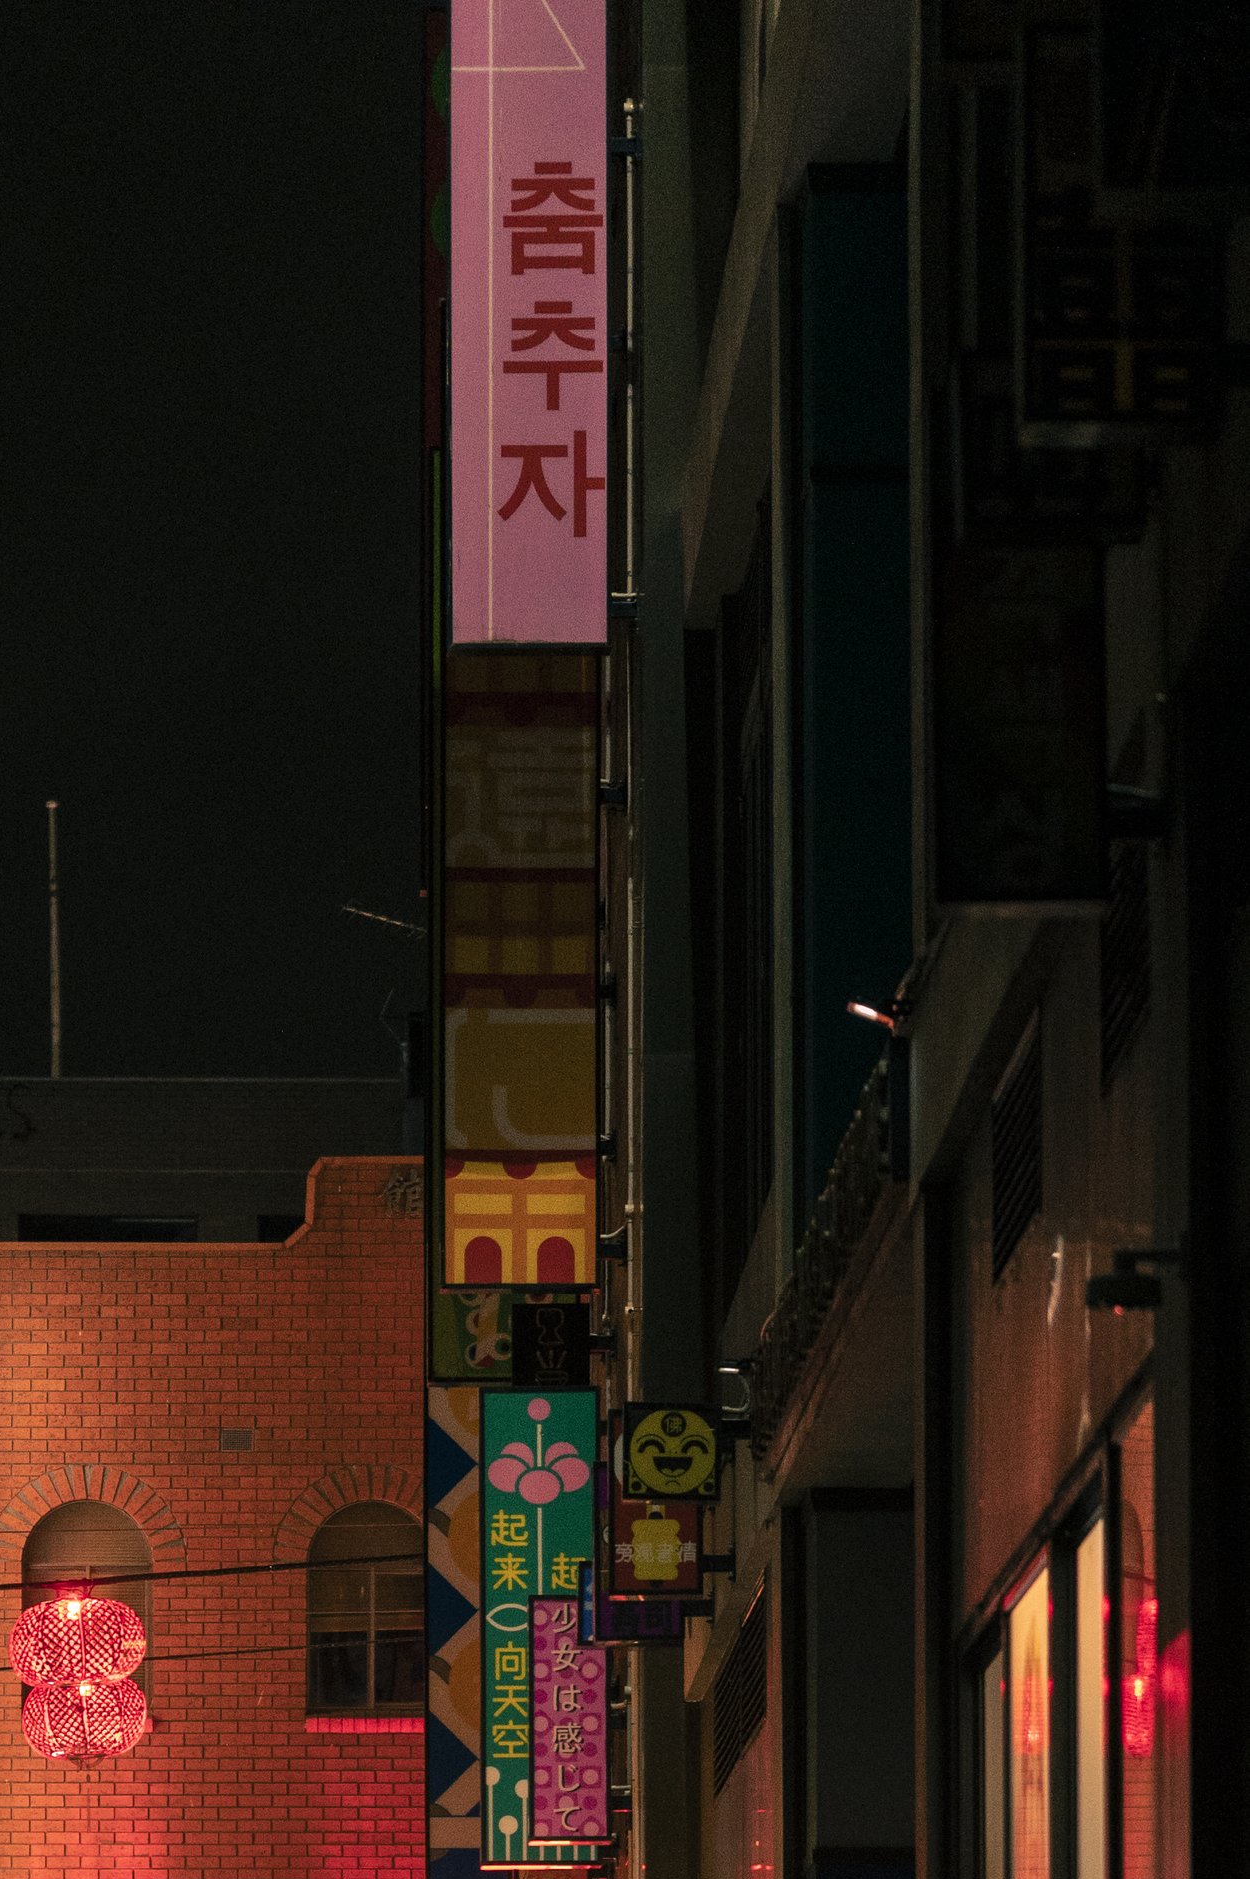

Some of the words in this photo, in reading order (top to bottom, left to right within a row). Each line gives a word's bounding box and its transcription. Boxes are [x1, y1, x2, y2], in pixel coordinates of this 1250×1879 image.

[498, 161, 605, 537] 춤추자
[551, 1602, 583, 1833] 少女は感じて
